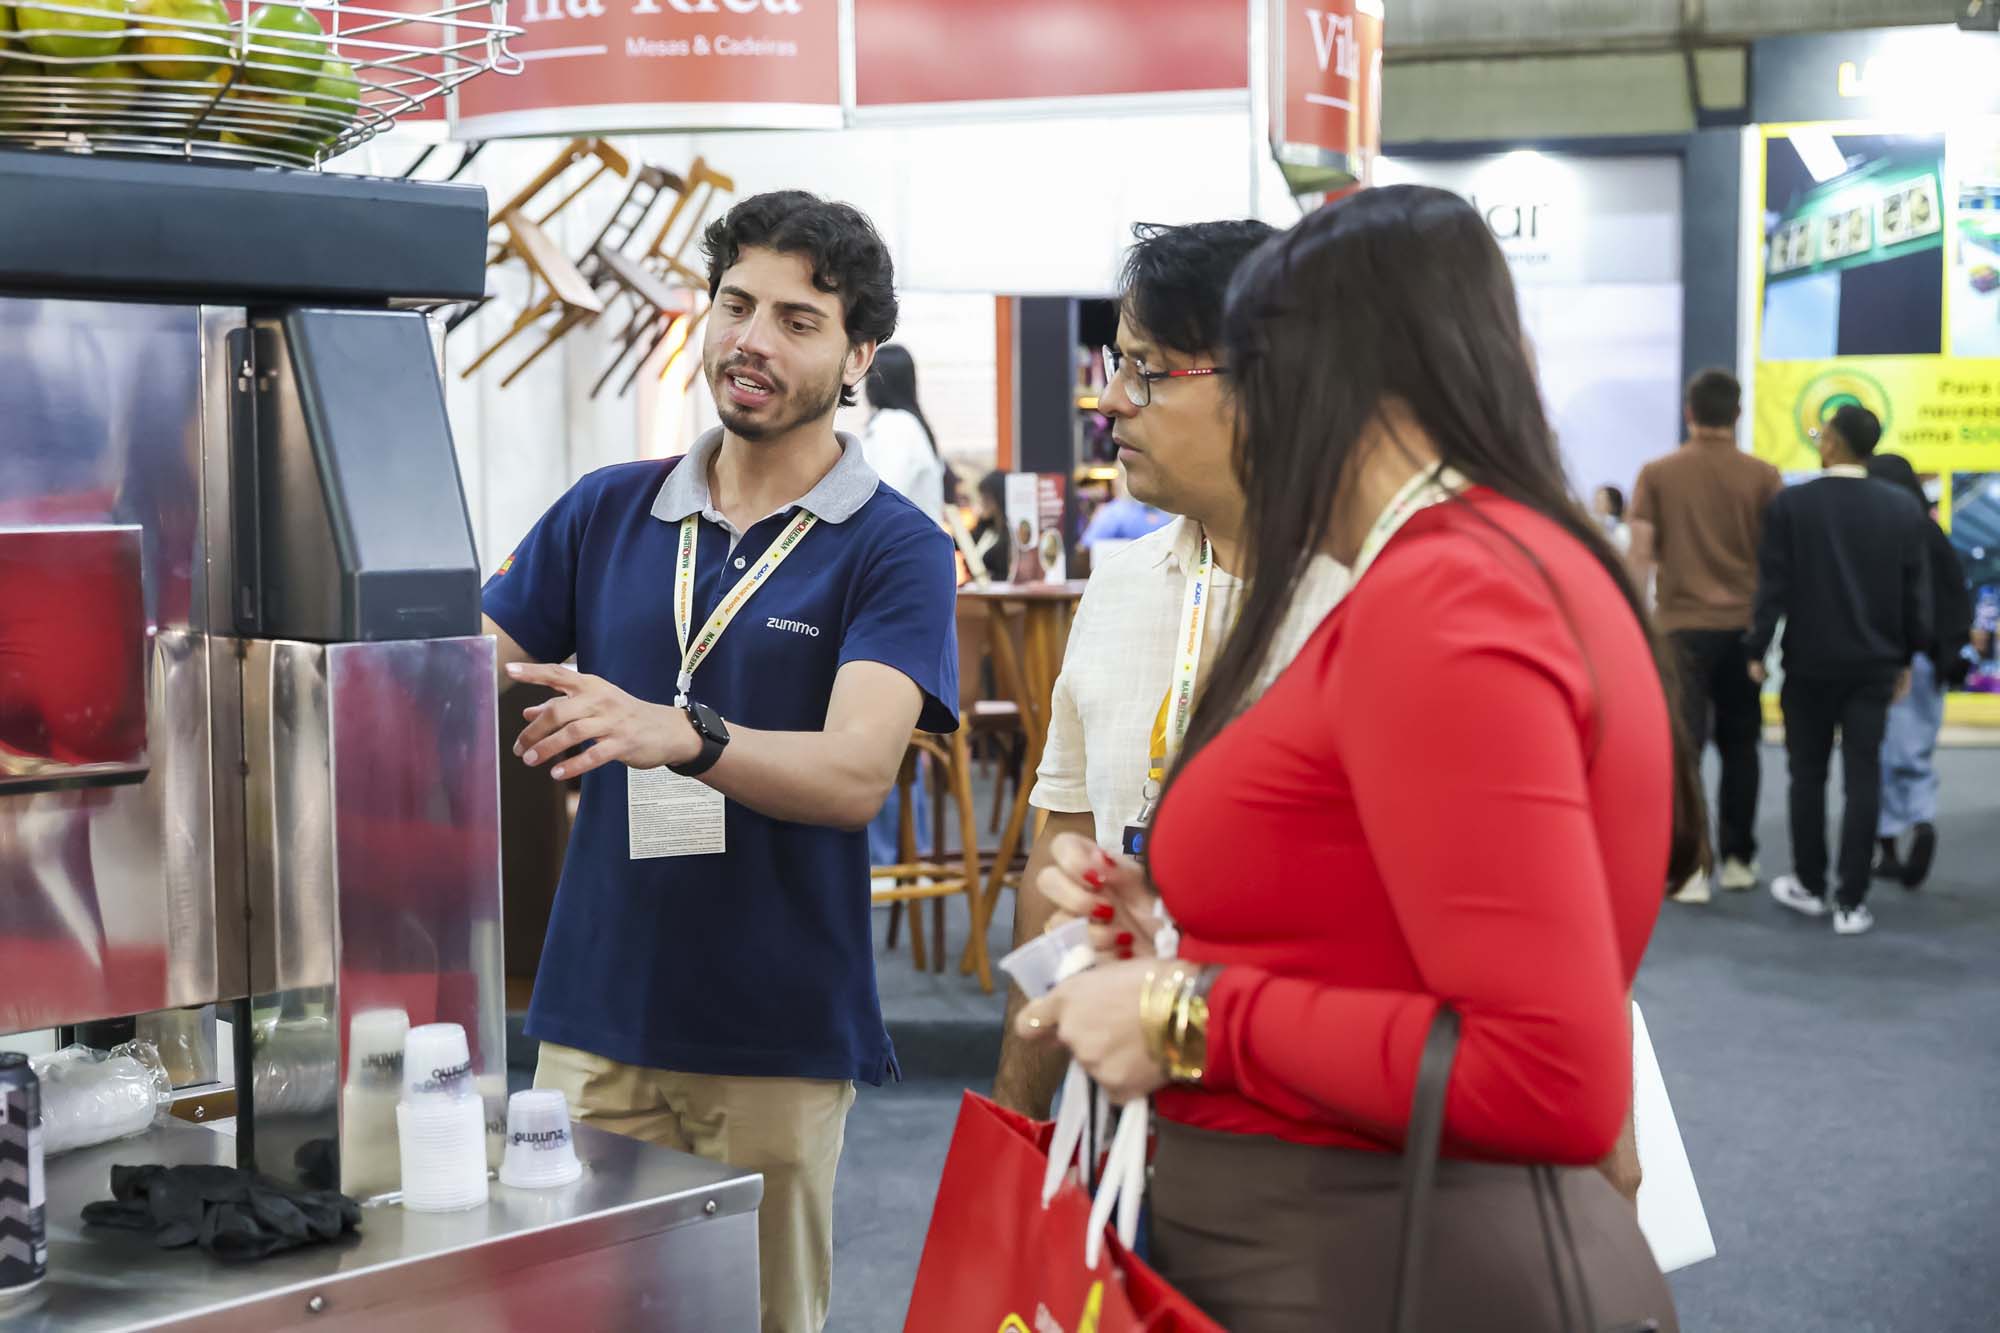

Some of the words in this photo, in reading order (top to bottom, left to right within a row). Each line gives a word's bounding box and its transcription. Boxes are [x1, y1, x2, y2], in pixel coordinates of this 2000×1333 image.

[625, 36, 689, 56] Mesas
[693, 34, 710, 56] &
[713, 35, 797, 56] Cadeiras
[766, 616, 820, 637] zummo
[514, 1128, 564, 1143] zummo
